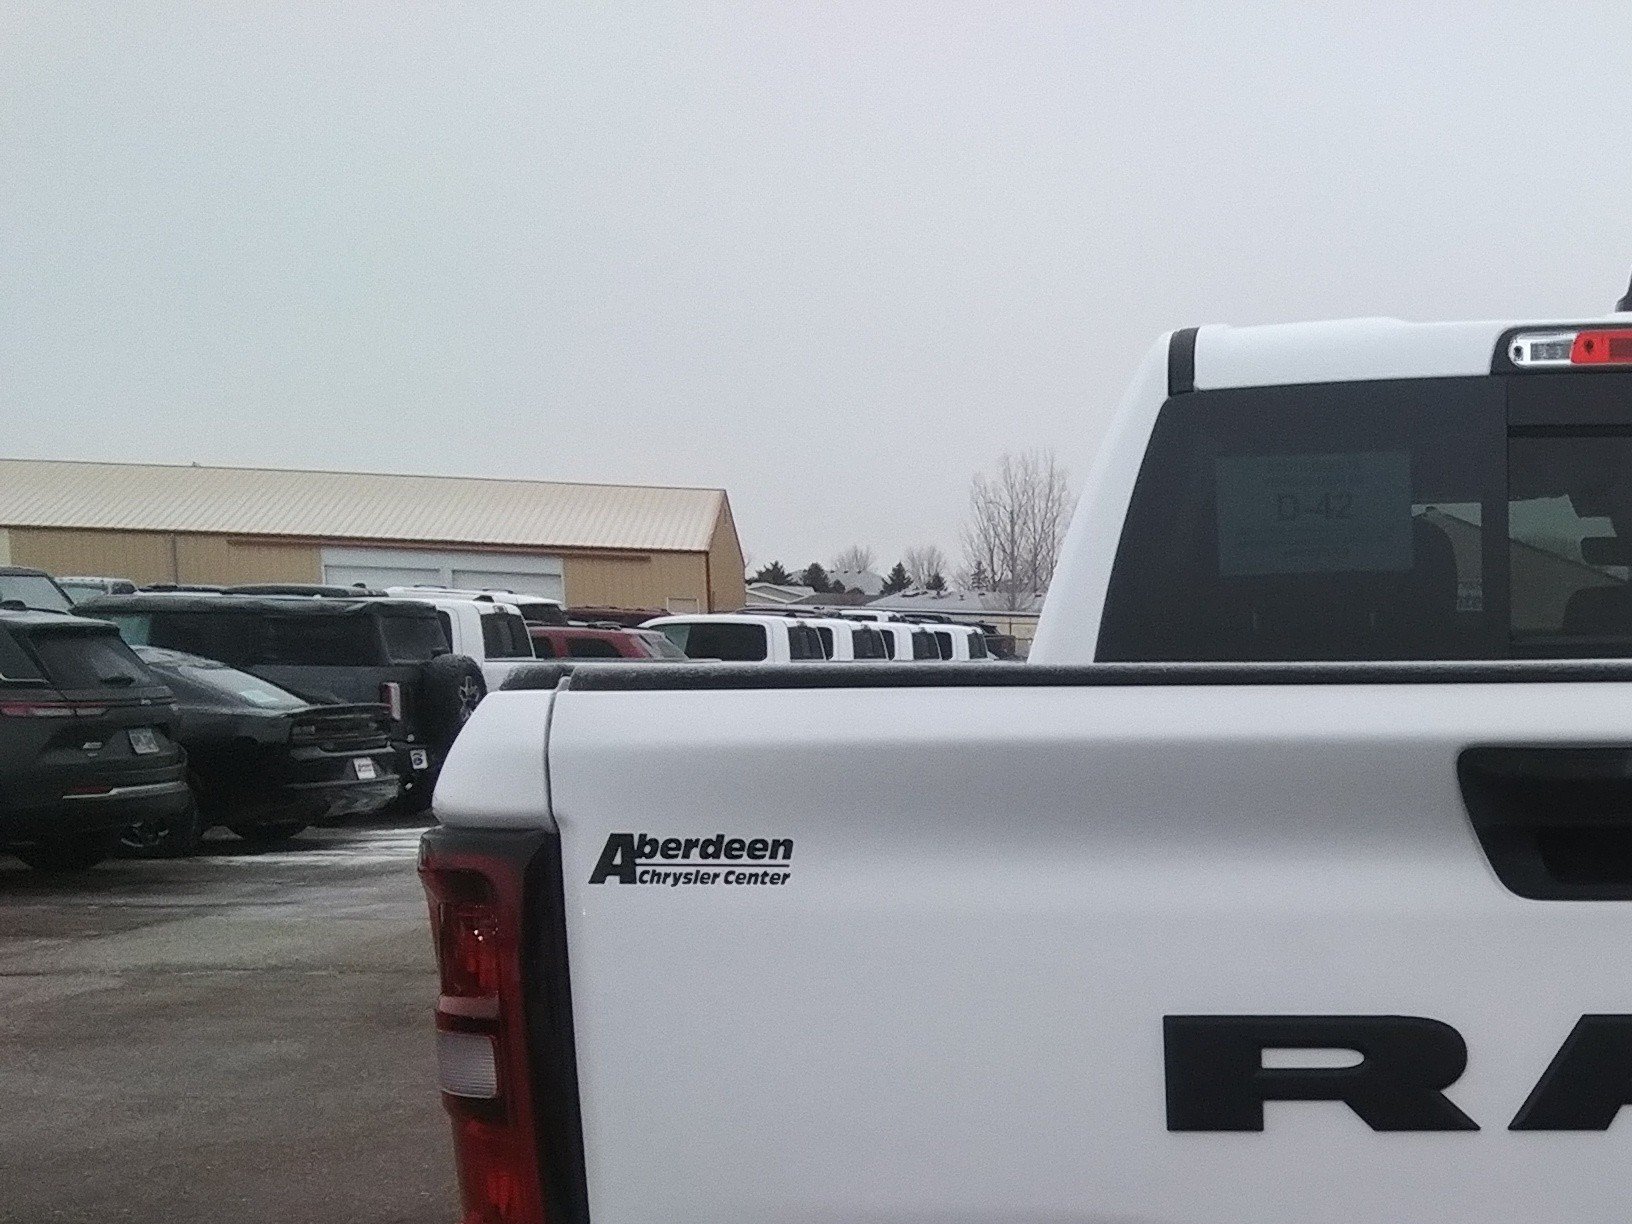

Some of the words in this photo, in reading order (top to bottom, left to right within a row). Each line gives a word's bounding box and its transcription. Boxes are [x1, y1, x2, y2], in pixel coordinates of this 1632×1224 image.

[588, 832, 794, 884] Aberdeen
[638, 869, 720, 887] Chrysler
[723, 869, 791, 885] Center
